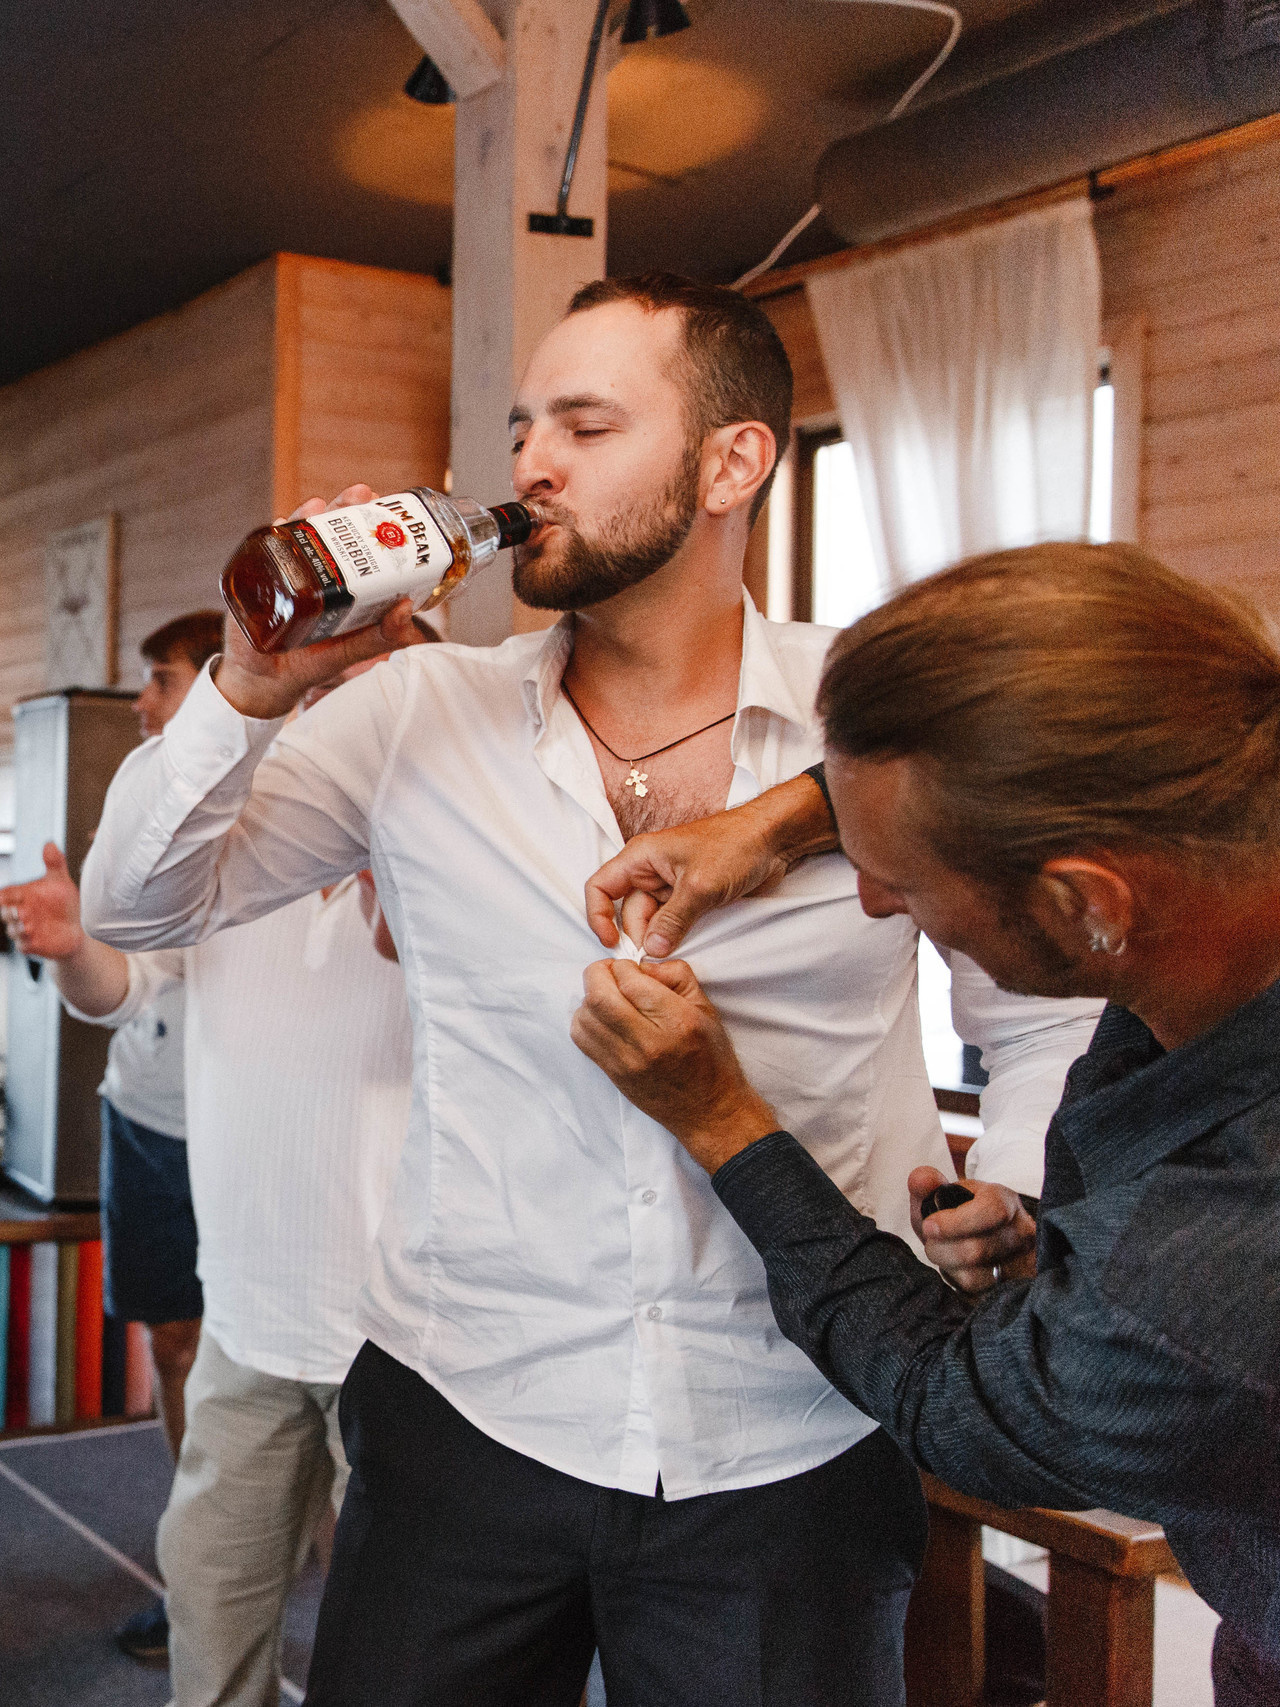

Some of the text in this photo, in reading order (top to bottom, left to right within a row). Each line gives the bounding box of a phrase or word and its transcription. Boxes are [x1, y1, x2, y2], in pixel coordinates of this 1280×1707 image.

[328, 518, 373, 577] BOURBON
[331, 536, 350, 562] WHISKEY
[342, 516, 381, 573] KENTUCKY STRAIGHT
[376, 501, 431, 569] JIM BEAM
[304, 546, 314, 559] alc.
[312, 558, 326, 574] 40%
[320, 573, 332, 587] vol.
